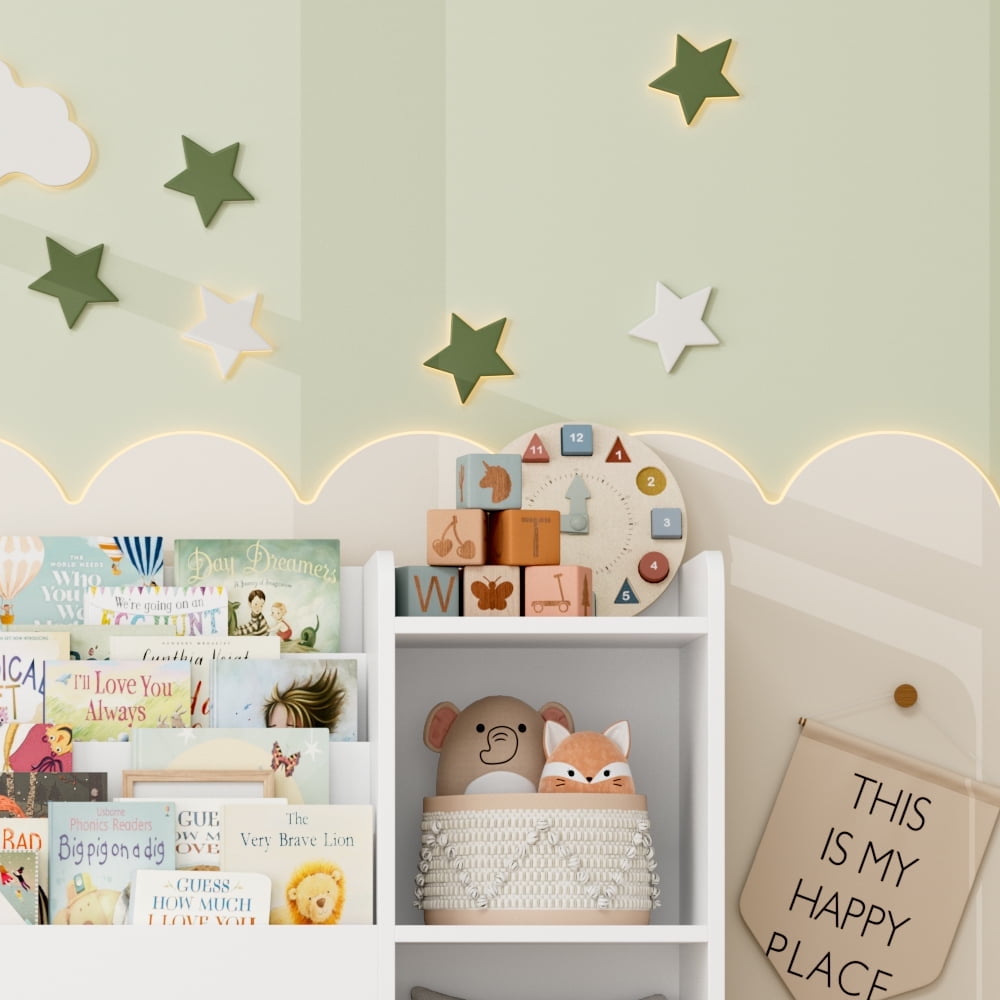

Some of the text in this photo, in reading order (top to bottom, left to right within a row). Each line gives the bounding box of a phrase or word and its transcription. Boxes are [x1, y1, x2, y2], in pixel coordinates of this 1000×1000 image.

[569, 433, 584, 443] 12
[530, 445, 543, 454] 11
[615, 450, 622, 460] 1
[647, 477, 655, 487] 2
[663, 518, 671, 527] 3
[521, 517, 551, 558] T
[187, 539, 337, 585] Day Dreamers
[650, 561, 658, 571] 4
[52, 571, 101, 586] Who
[41, 586, 80, 601] You
[413, 575, 455, 613] W
[622, 591, 630, 601] 5
[115, 596, 204, 613] We're going on an
[94, 670, 137, 695] Love
[140, 674, 172, 697] You
[85, 699, 146, 728] Always
[853, 772, 932, 832] THIS
[96, 808, 125, 816] Usborne
[286, 812, 309, 825] The
[70, 818, 153, 832] Phonics Readers
[58, 834, 165, 866] Big pig on a dig
[240, 832, 354, 853] Very Brave Lion
[820, 827, 920, 888] IS MY
[177, 878, 230, 893] GUESS
[153, 896, 252, 911] HOW MUCH
[789, 878, 911, 947] HAPPY
